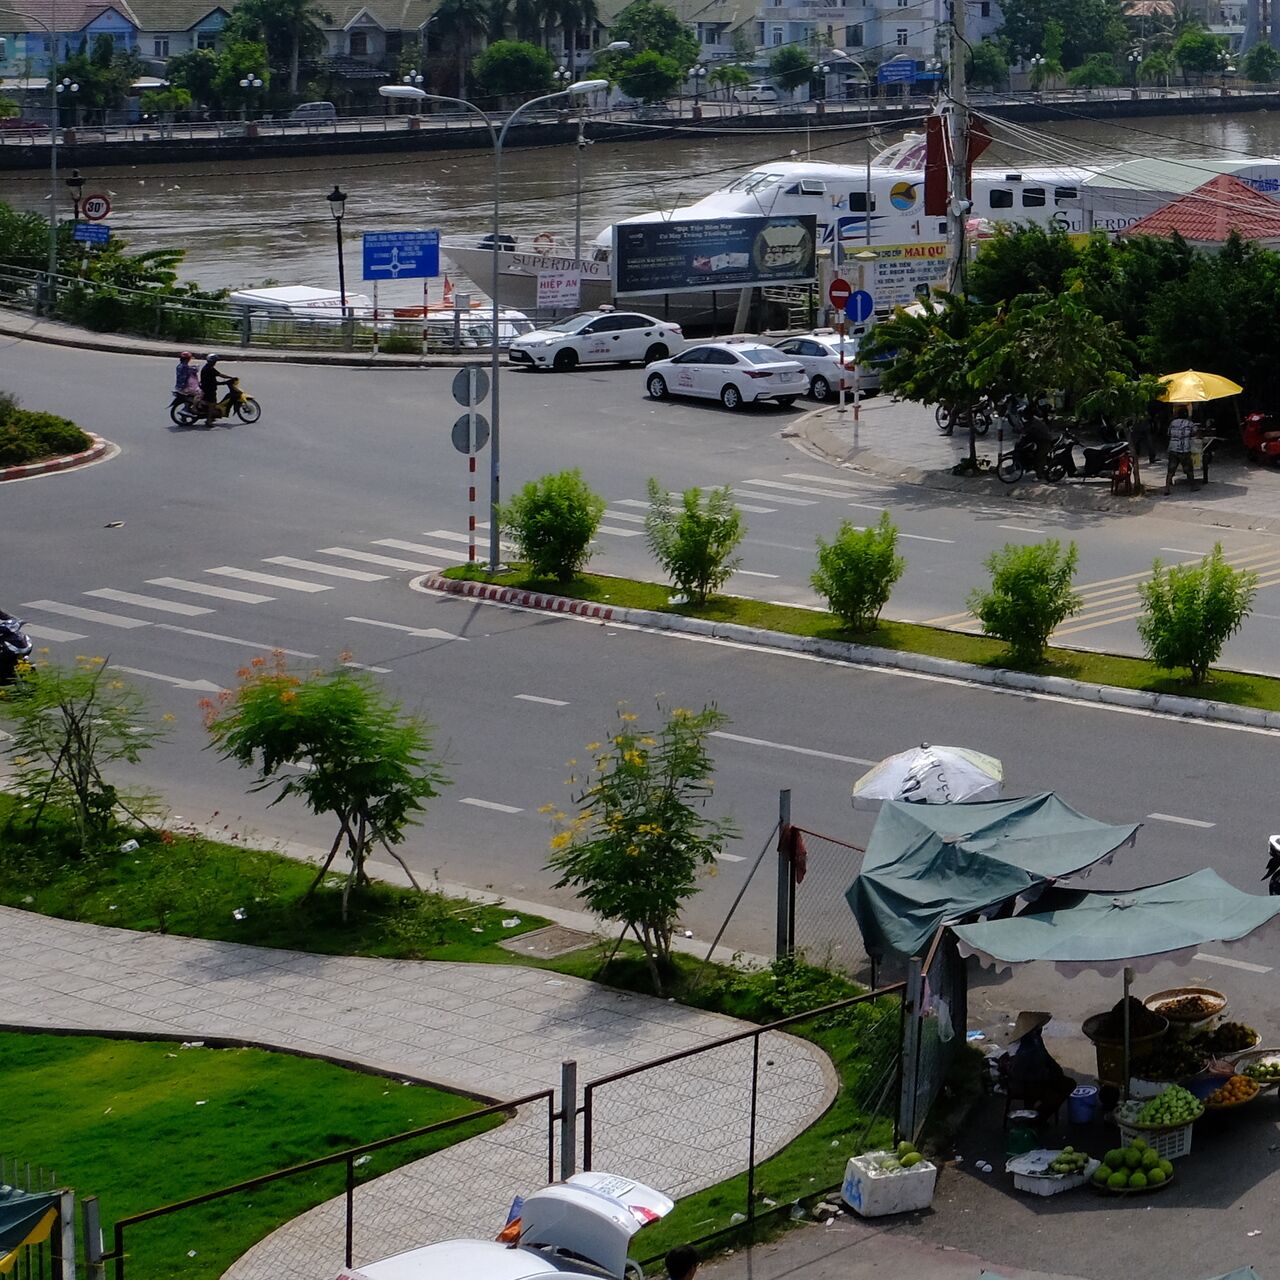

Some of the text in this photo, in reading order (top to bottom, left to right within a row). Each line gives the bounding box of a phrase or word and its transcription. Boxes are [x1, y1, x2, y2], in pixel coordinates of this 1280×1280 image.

[904, 248, 925, 258] MAI
[927, 245, 946, 256] QU
[540, 278, 577, 290] HIỆP AN
